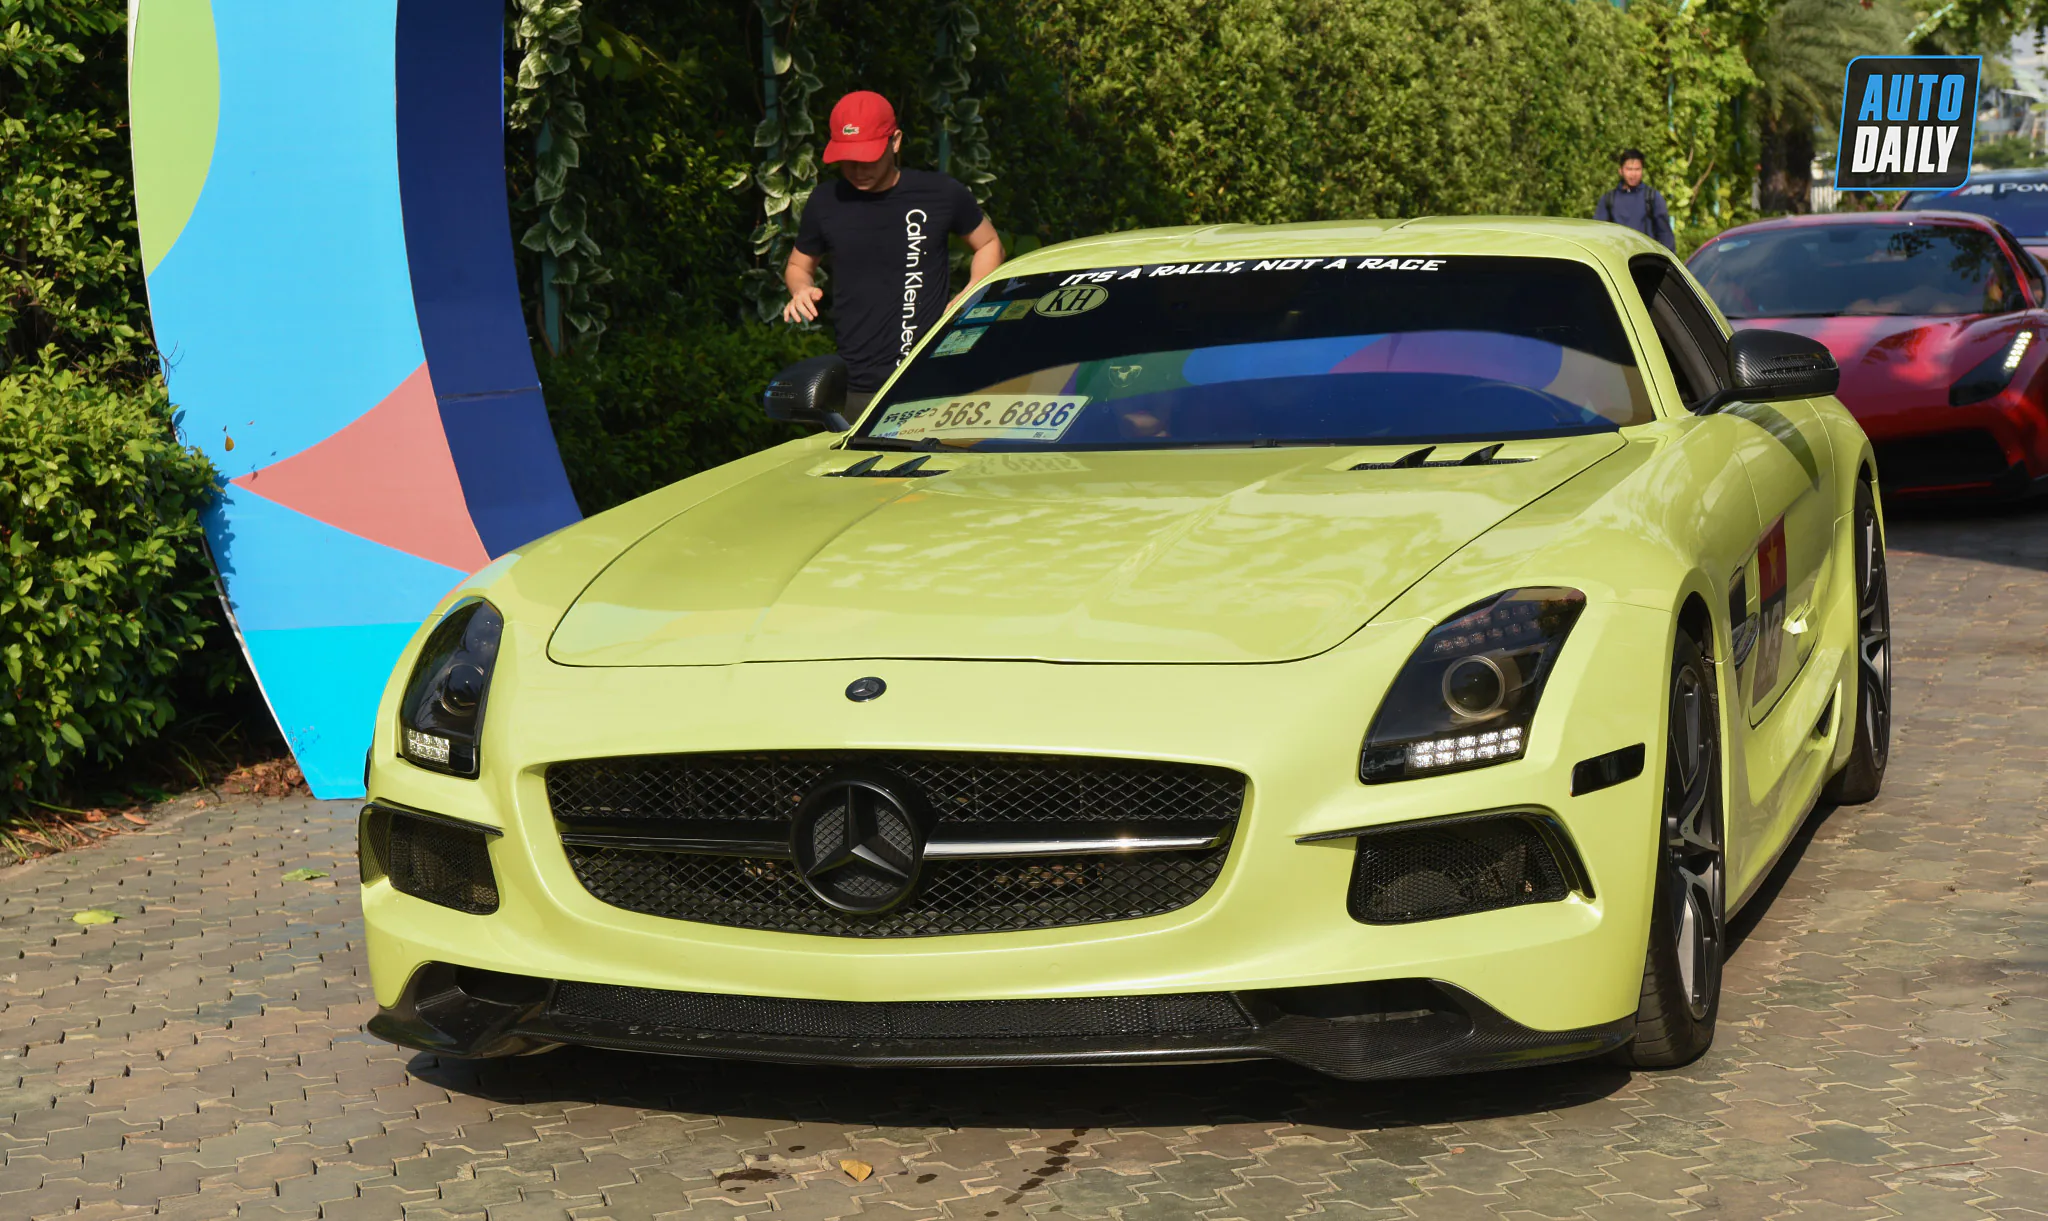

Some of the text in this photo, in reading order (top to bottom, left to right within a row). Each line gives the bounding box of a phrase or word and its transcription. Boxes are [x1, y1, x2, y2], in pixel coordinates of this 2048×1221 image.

[905, 208, 927, 268] Calvin
[1059, 258, 1447, 286] IT'S A RALLY, NOT A RACE
[902, 271, 923, 318] Klein
[1046, 288, 1096, 312] KH
[872, 427, 925, 438] AMBODIA
